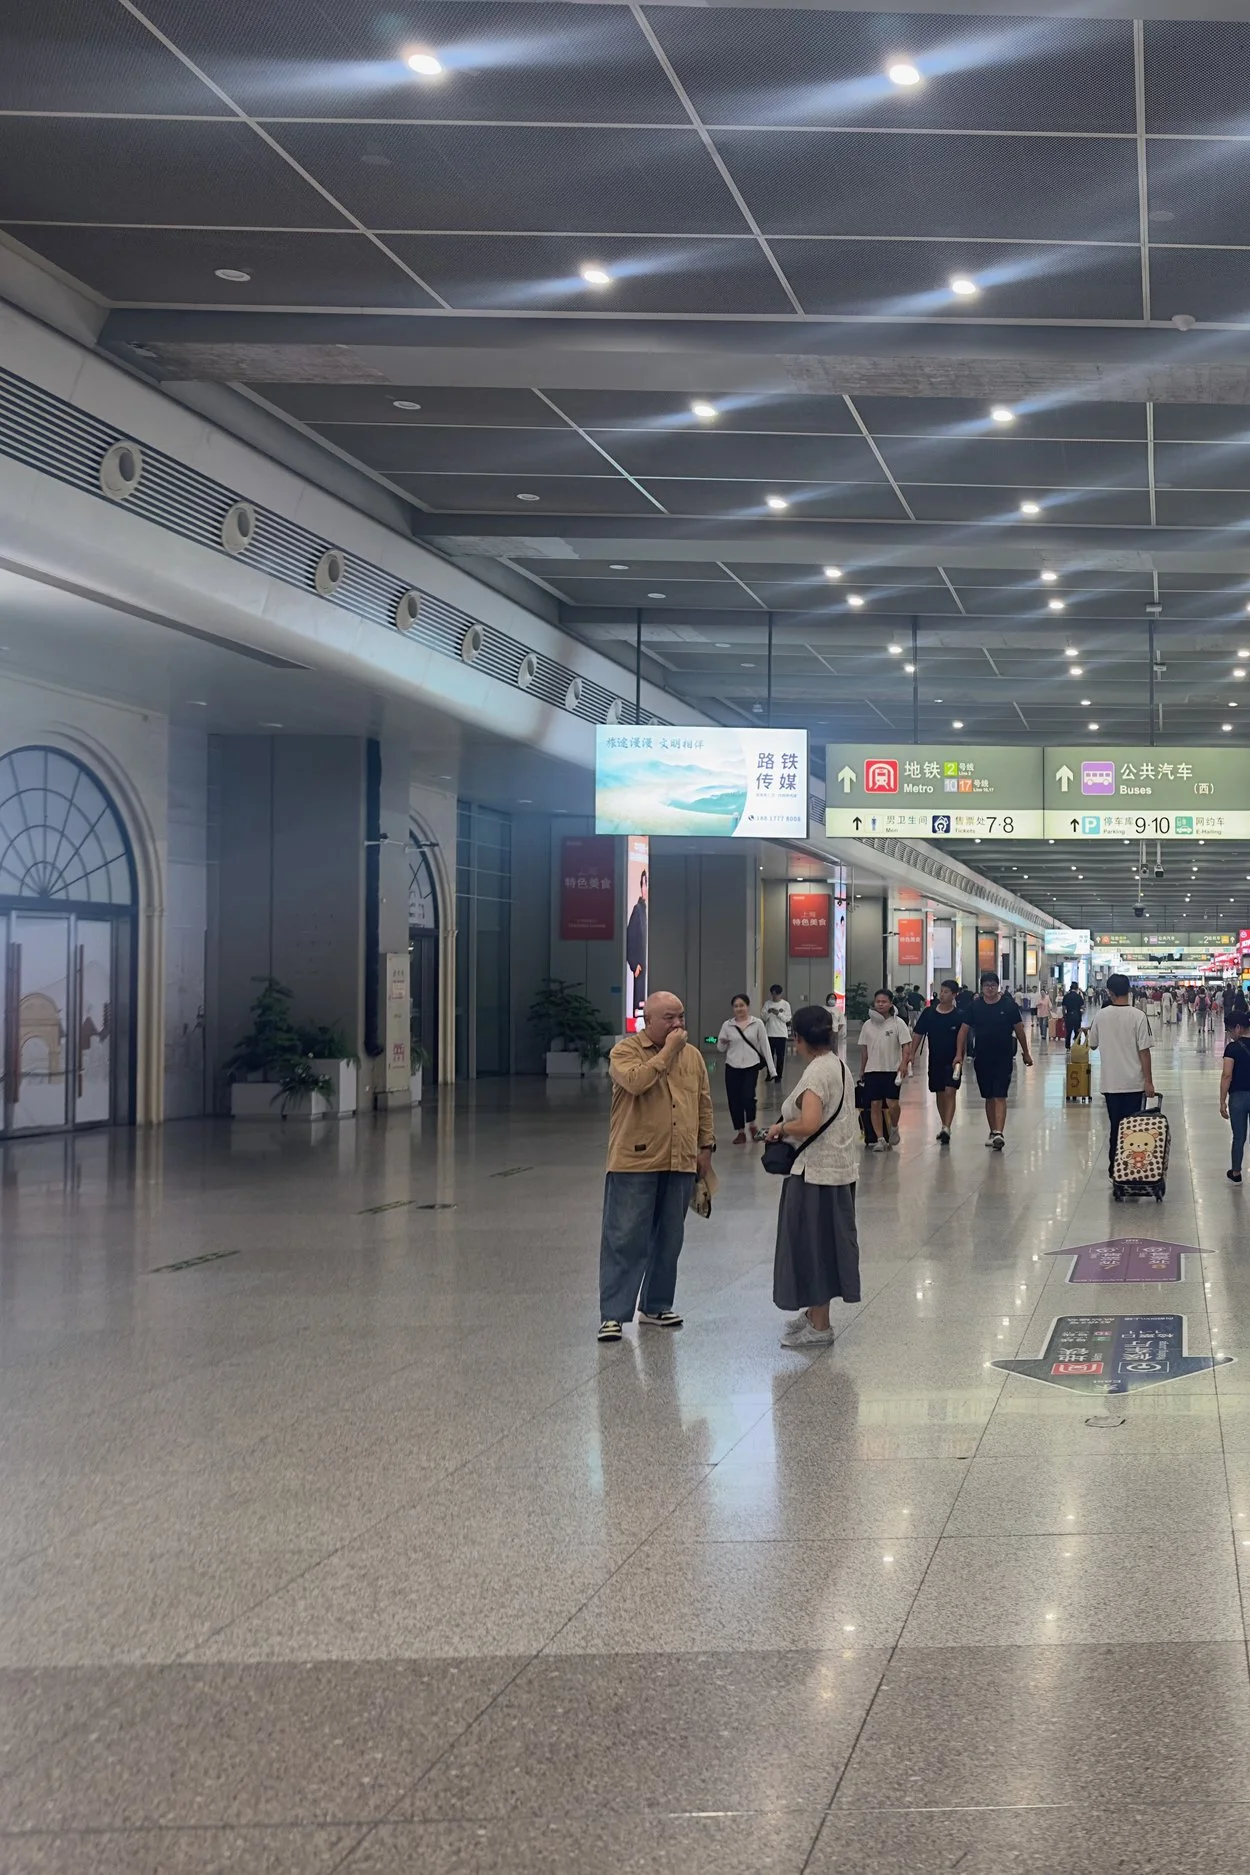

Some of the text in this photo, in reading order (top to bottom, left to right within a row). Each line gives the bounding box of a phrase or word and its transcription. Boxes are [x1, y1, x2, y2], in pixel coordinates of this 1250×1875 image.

[757, 752, 799, 770] 路铁
[904, 760, 974, 778] 地铁 2 号线
[1120, 762, 1193, 780] 公共汽车
[756, 773, 797, 790] 传媒
[945, 779, 957, 792] 10
[960, 779, 971, 792] 17
[904, 783, 934, 793] Metro
[1120, 785, 1152, 795] Buses
[887, 816, 928, 825] 男卫生间
[955, 816, 985, 825] 售票处
[1104, 817, 1134, 826] 停车库
[1196, 817, 1225, 826] 网约车
[564, 877, 612, 889] 特色美食
[792, 918, 827, 926] 特色美食
